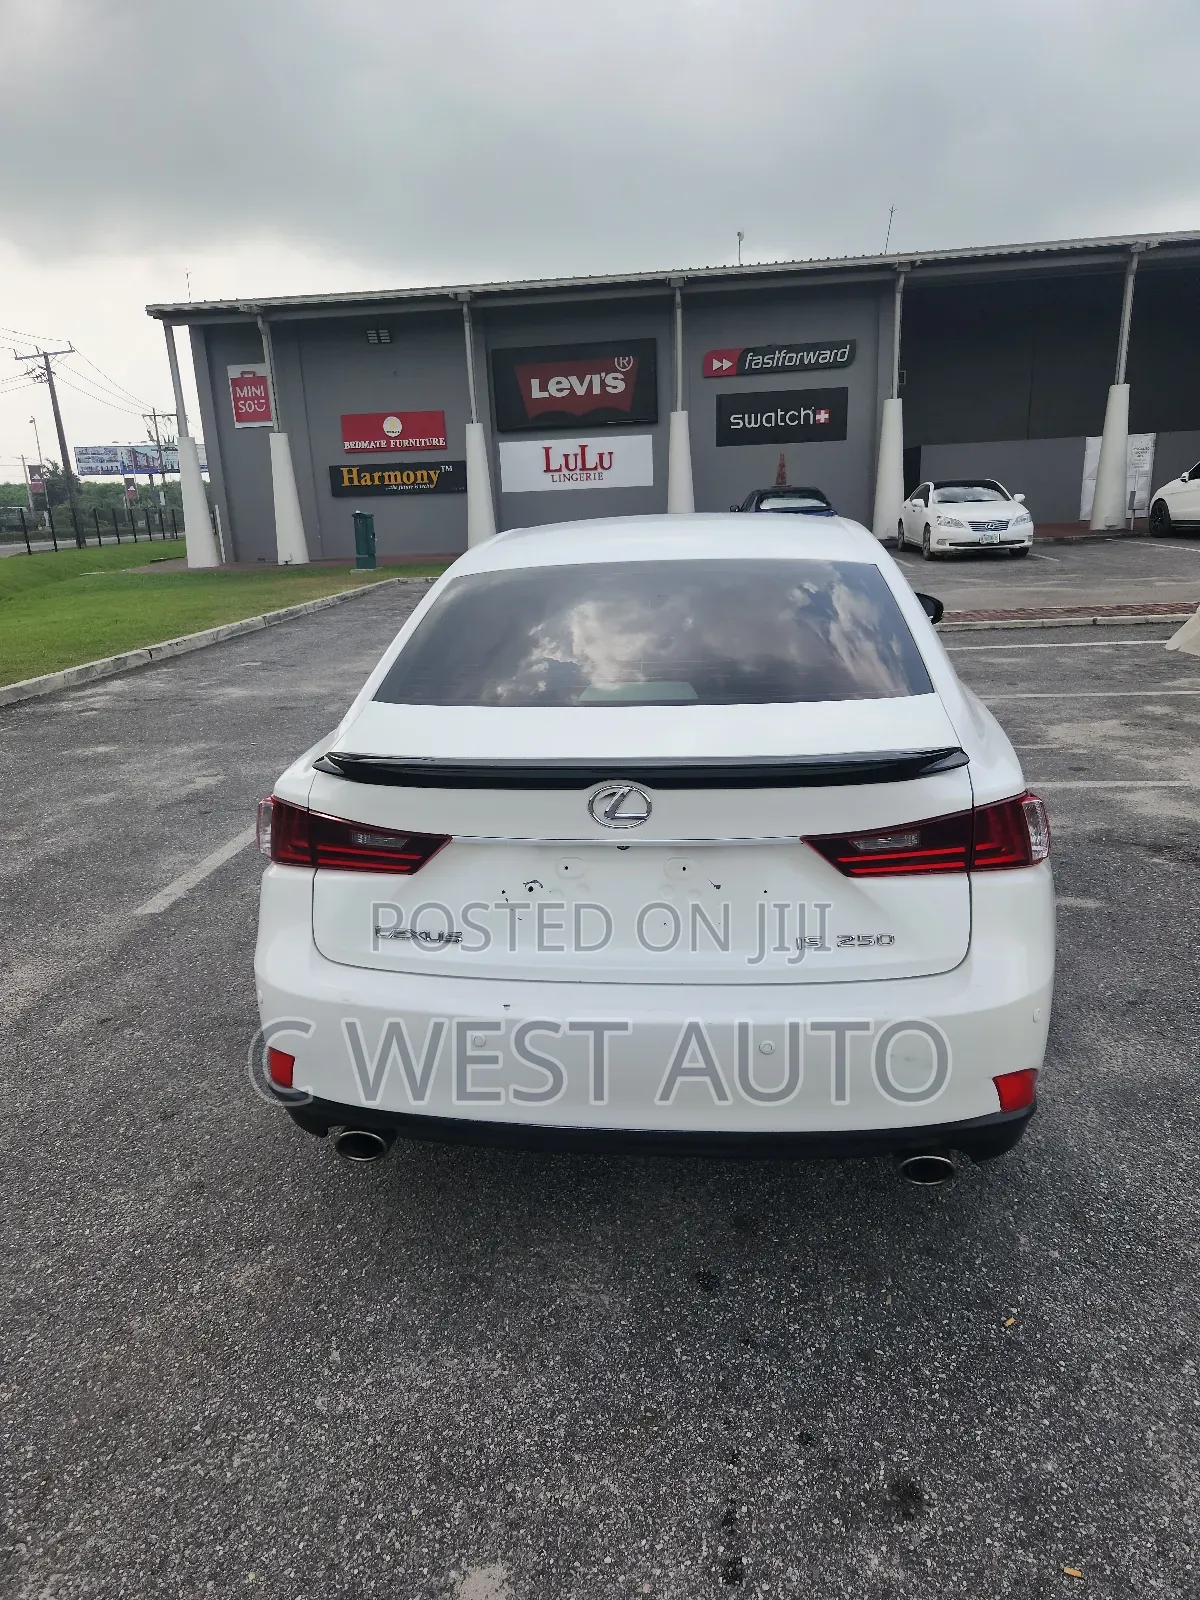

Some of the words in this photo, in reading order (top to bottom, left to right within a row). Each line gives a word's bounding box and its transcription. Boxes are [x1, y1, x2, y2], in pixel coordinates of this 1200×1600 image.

[744, 345, 851, 371] fastforward
[236, 385, 265, 398] MINI
[730, 406, 815, 429] swatch
[343, 439, 387, 450] BEDMATE
[390, 437, 446, 448] FURNITURE
[542, 444, 614, 473] LuLu
[340, 467, 441, 488] Harmony
[551, 472, 604, 483] LINGERIE
[374, 925, 464, 945] LEXUS
[835, 932, 896, 949] 250
